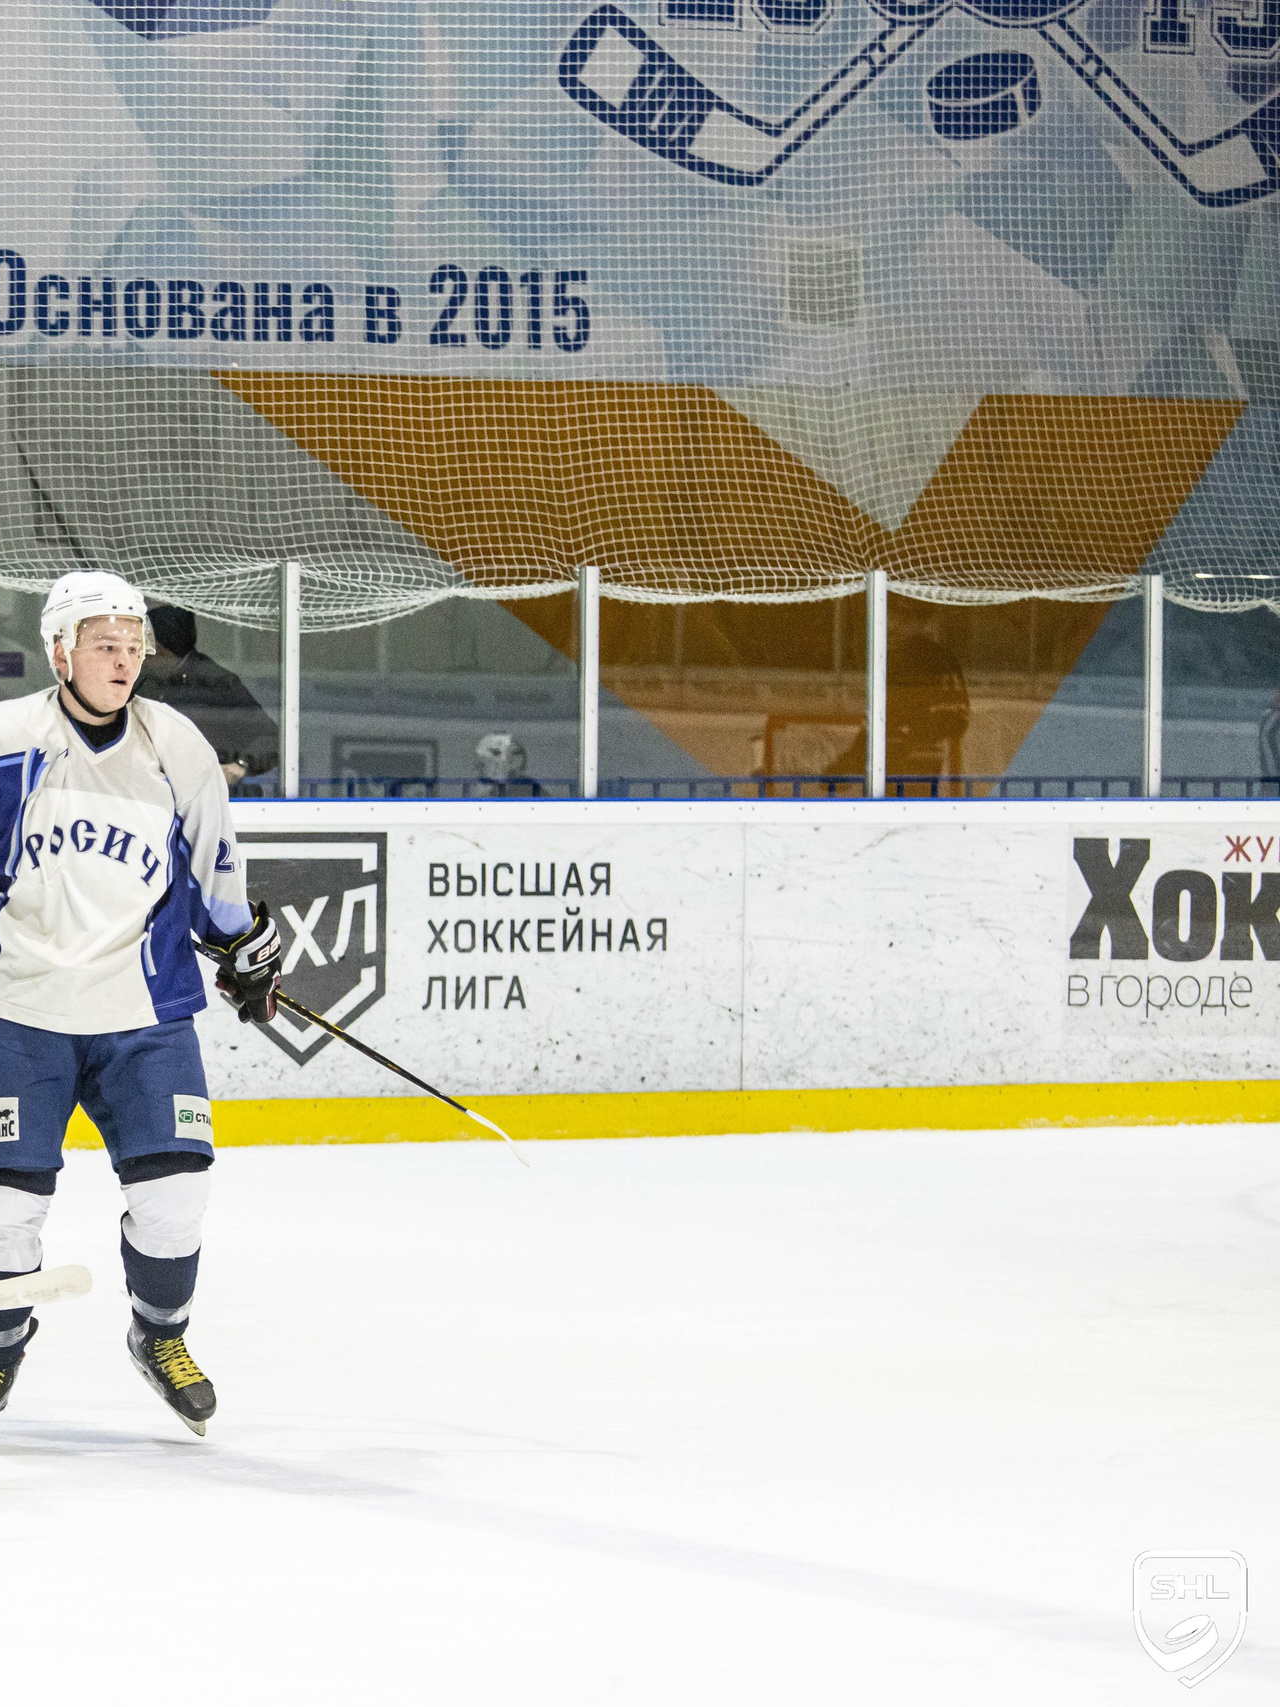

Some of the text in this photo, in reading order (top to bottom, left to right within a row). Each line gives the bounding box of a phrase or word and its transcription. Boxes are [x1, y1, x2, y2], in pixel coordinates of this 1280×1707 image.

[365, 284, 402, 345] в
[429, 263, 591, 353] 2015
[25, 819, 162, 887] РОСИЧ
[1223, 835, 1280, 863] ЖУ
[428, 861, 612, 898] ВЫСШАЯ
[277, 883, 378, 976] ХЛ
[426, 908, 669, 953] ХОККЕЙНАЯ
[422, 975, 527, 1010] ЛИГА
[1100, 974, 1254, 1018] городе
